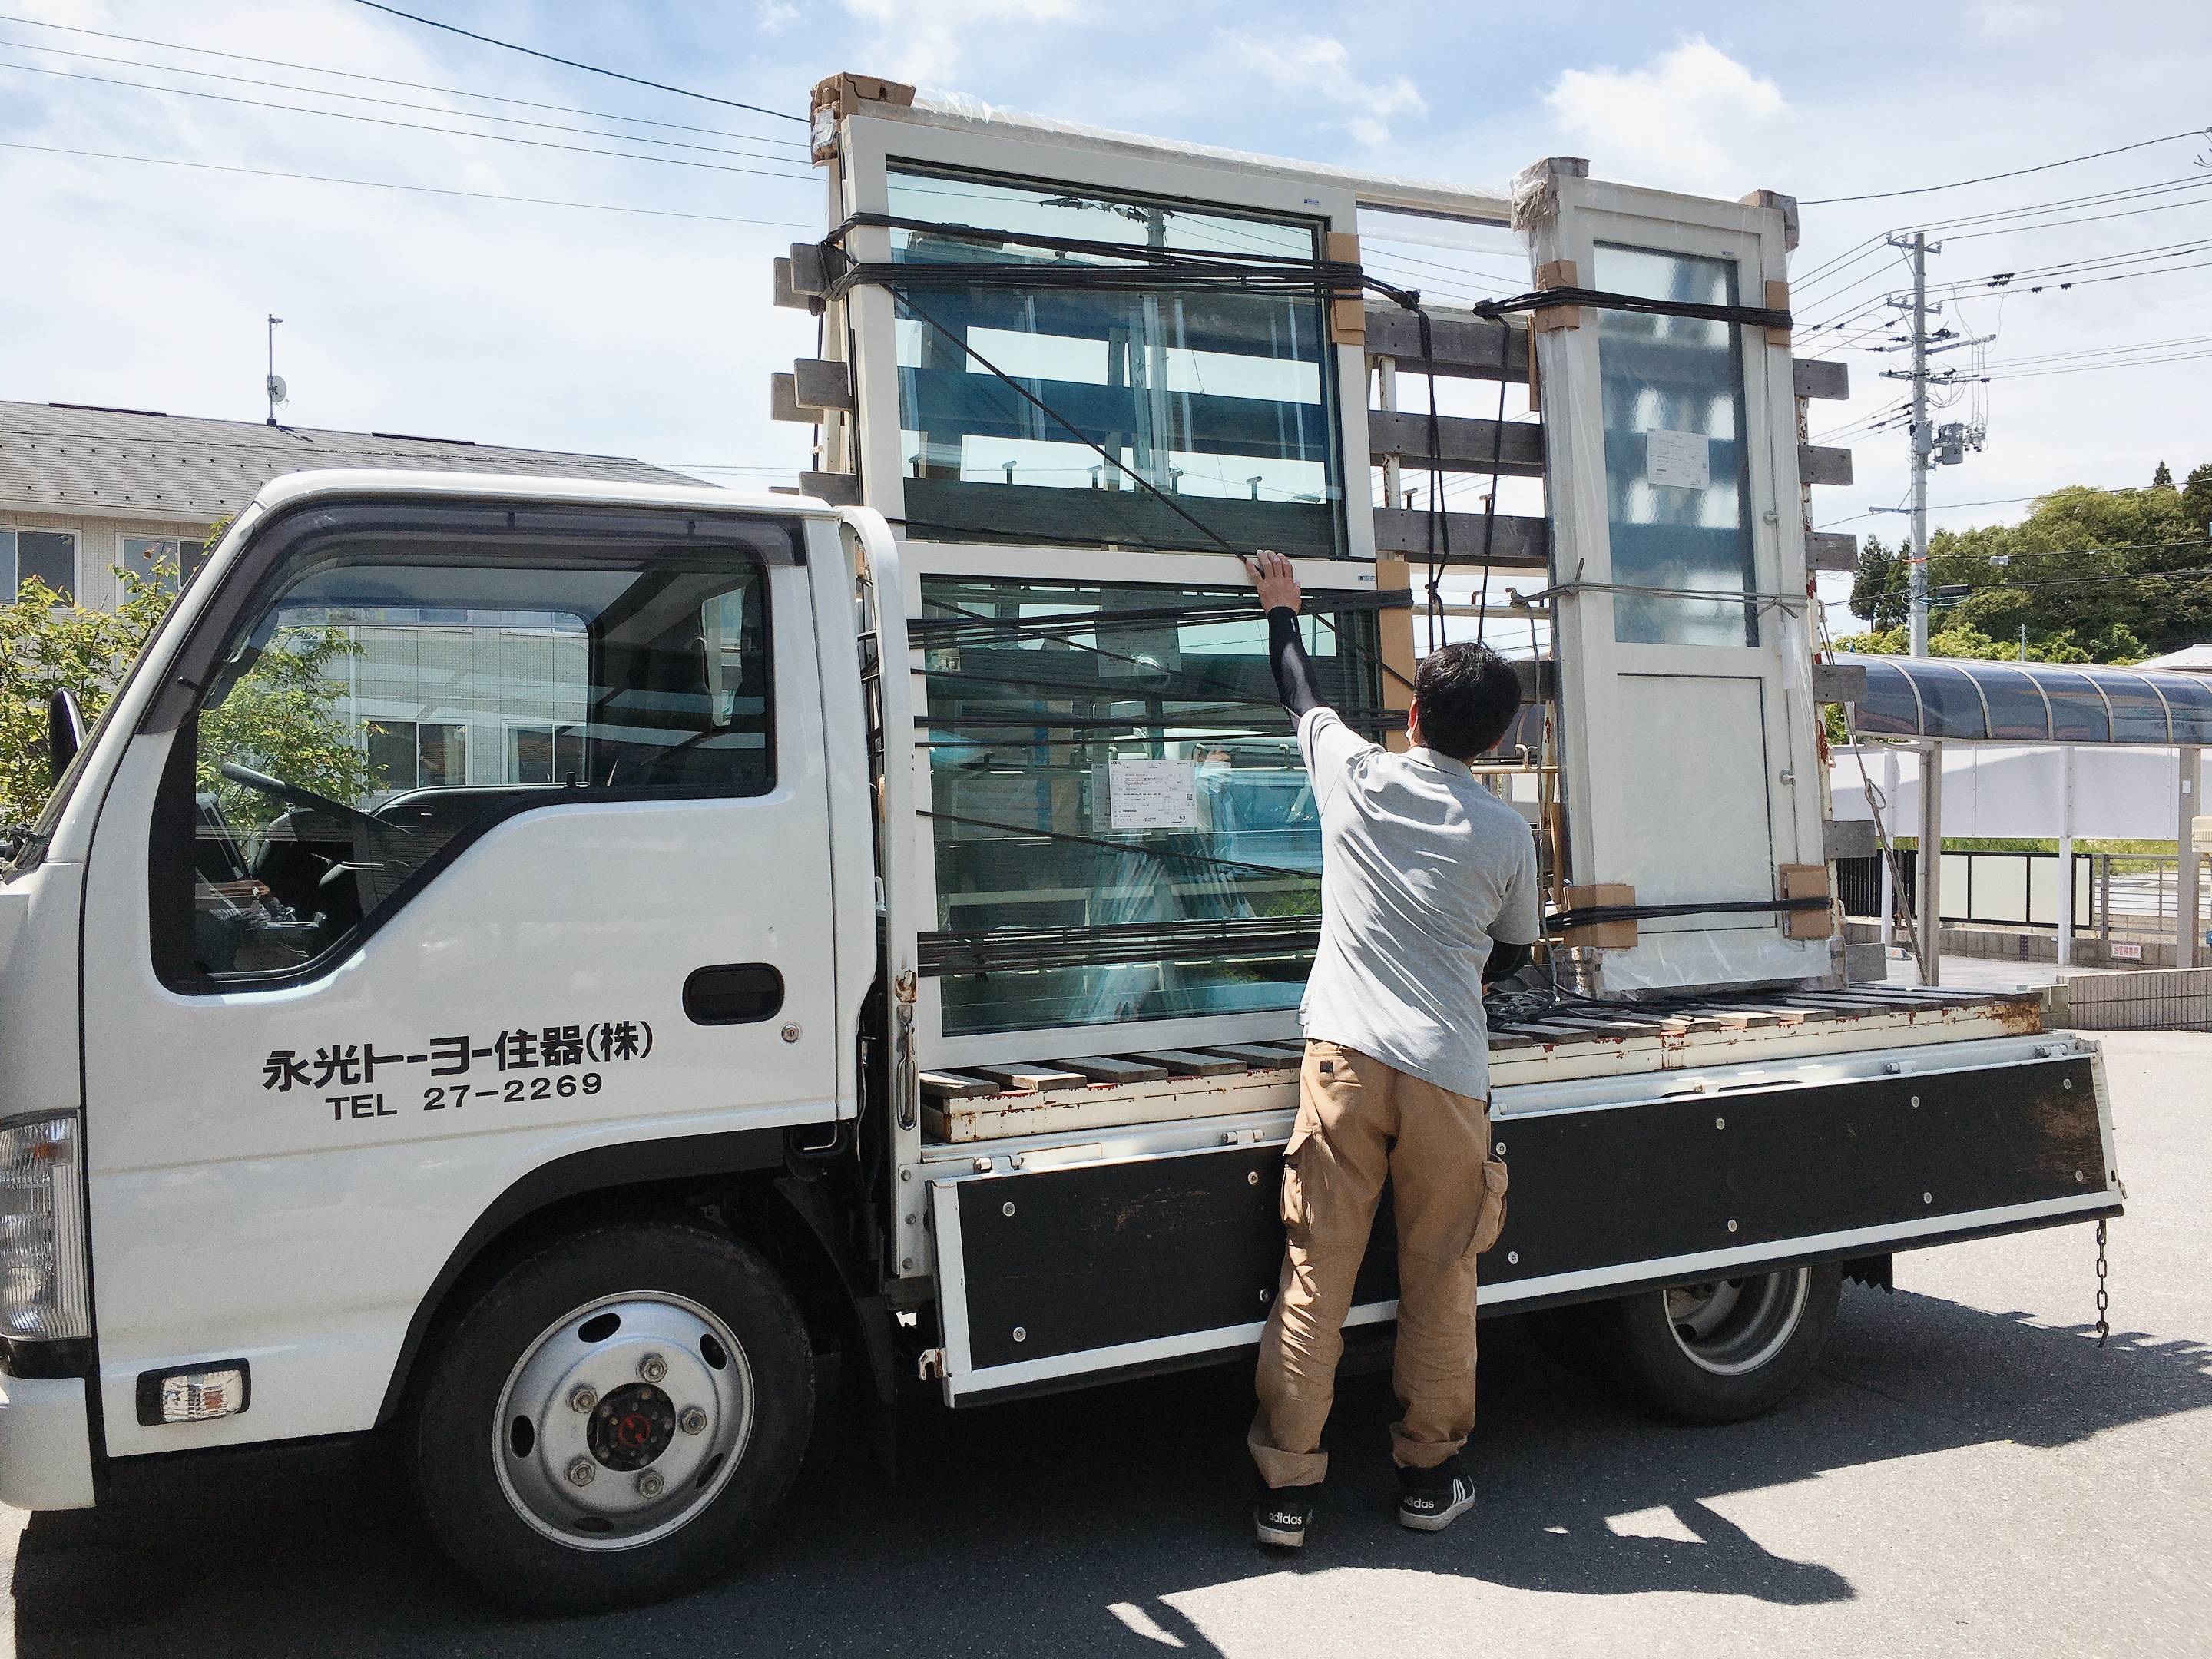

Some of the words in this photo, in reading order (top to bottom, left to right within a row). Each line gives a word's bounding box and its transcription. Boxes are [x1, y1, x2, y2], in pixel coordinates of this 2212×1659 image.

[263, 1021, 653, 1091] 永光トーヨー住器(株)
[326, 1094, 398, 1121] TEL
[423, 1073, 602, 1111] 27-2269
[1269, 1512, 1303, 1525] adidas
